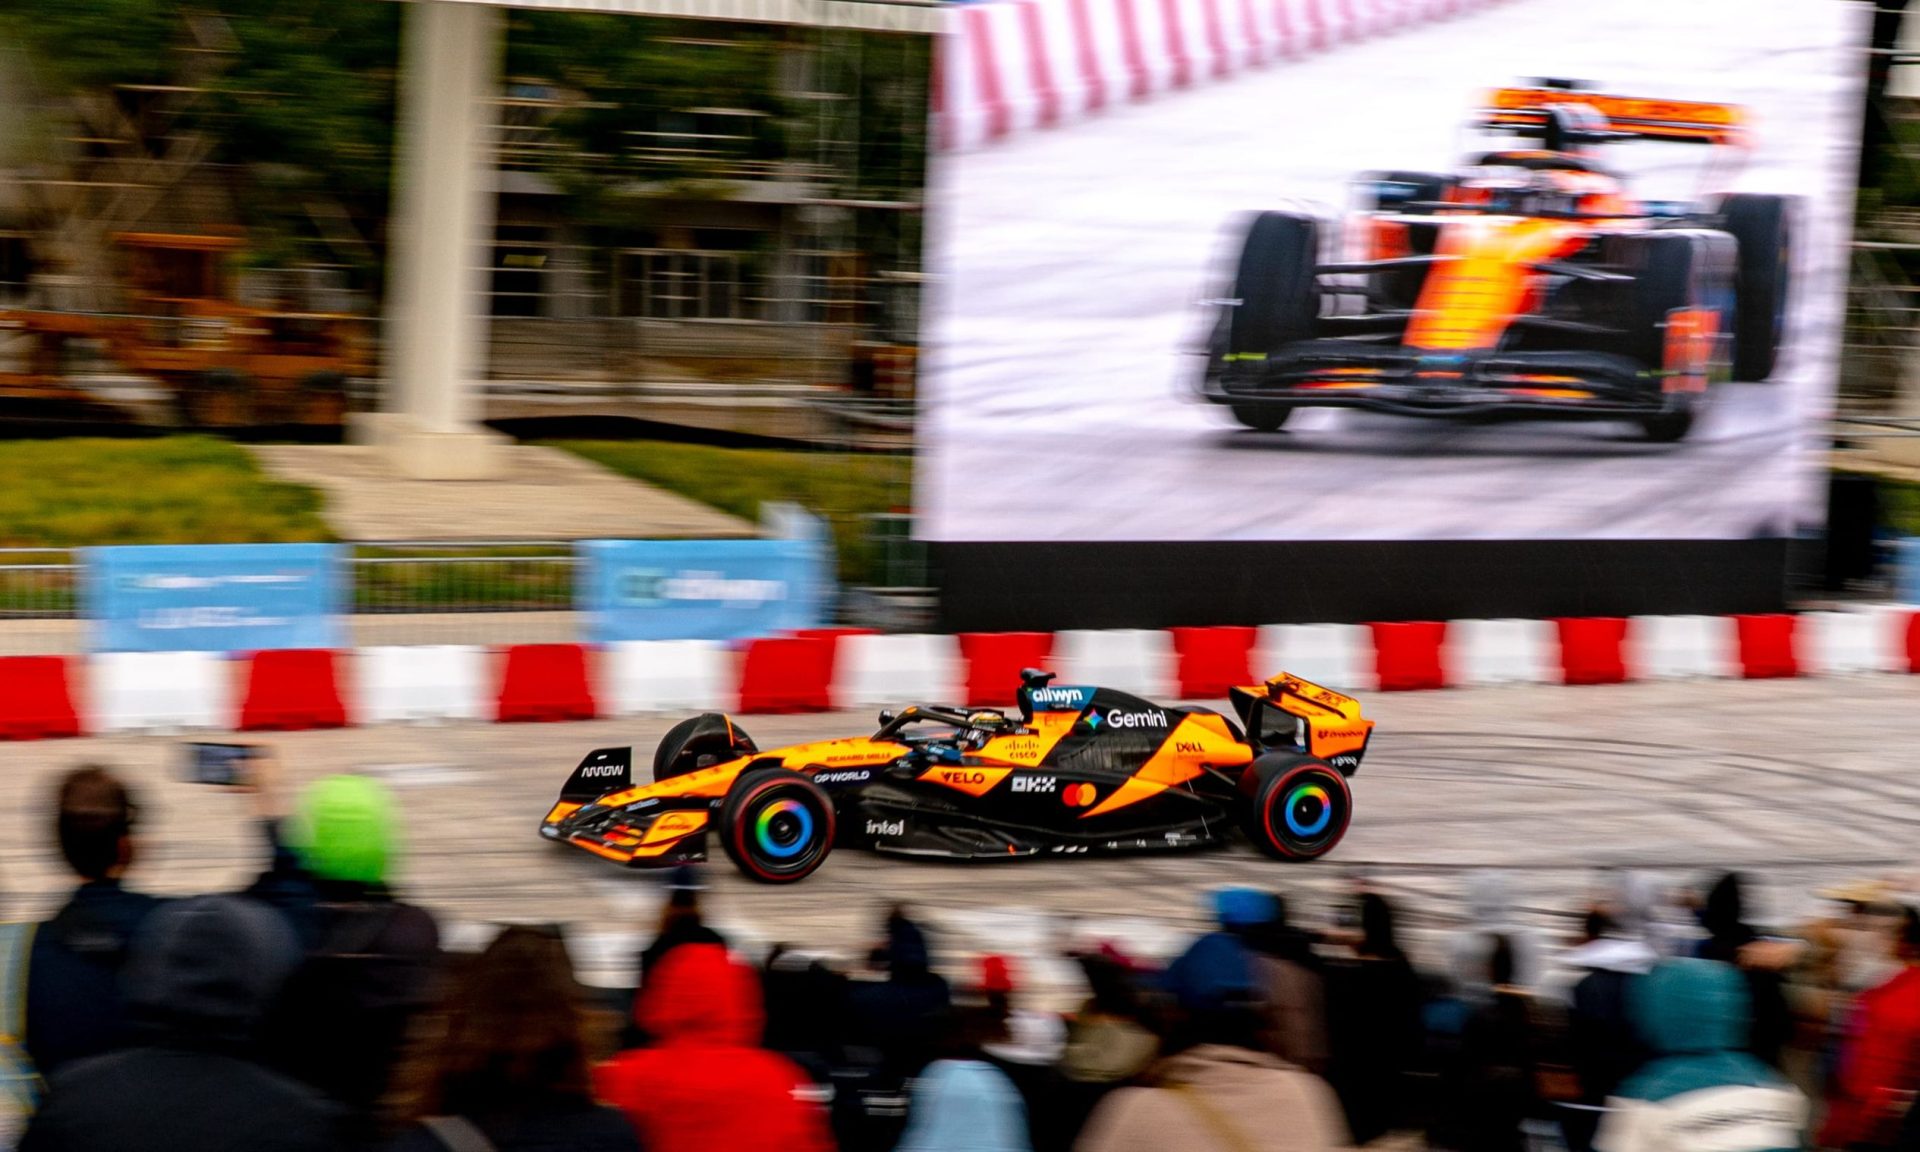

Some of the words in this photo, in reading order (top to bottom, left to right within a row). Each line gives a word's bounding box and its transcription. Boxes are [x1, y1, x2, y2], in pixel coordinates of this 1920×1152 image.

[1032, 687, 1083, 704] allwyn
[1107, 709, 1168, 728] Gemini
[1176, 742, 1205, 752] DELL
[1009, 751, 1038, 759] CISCO
[581, 765, 624, 778] ARROW
[831, 770, 870, 782] WORLD
[941, 771, 985, 784] VELO
[1011, 776, 1056, 792] OKX
[866, 819, 904, 836] intel
